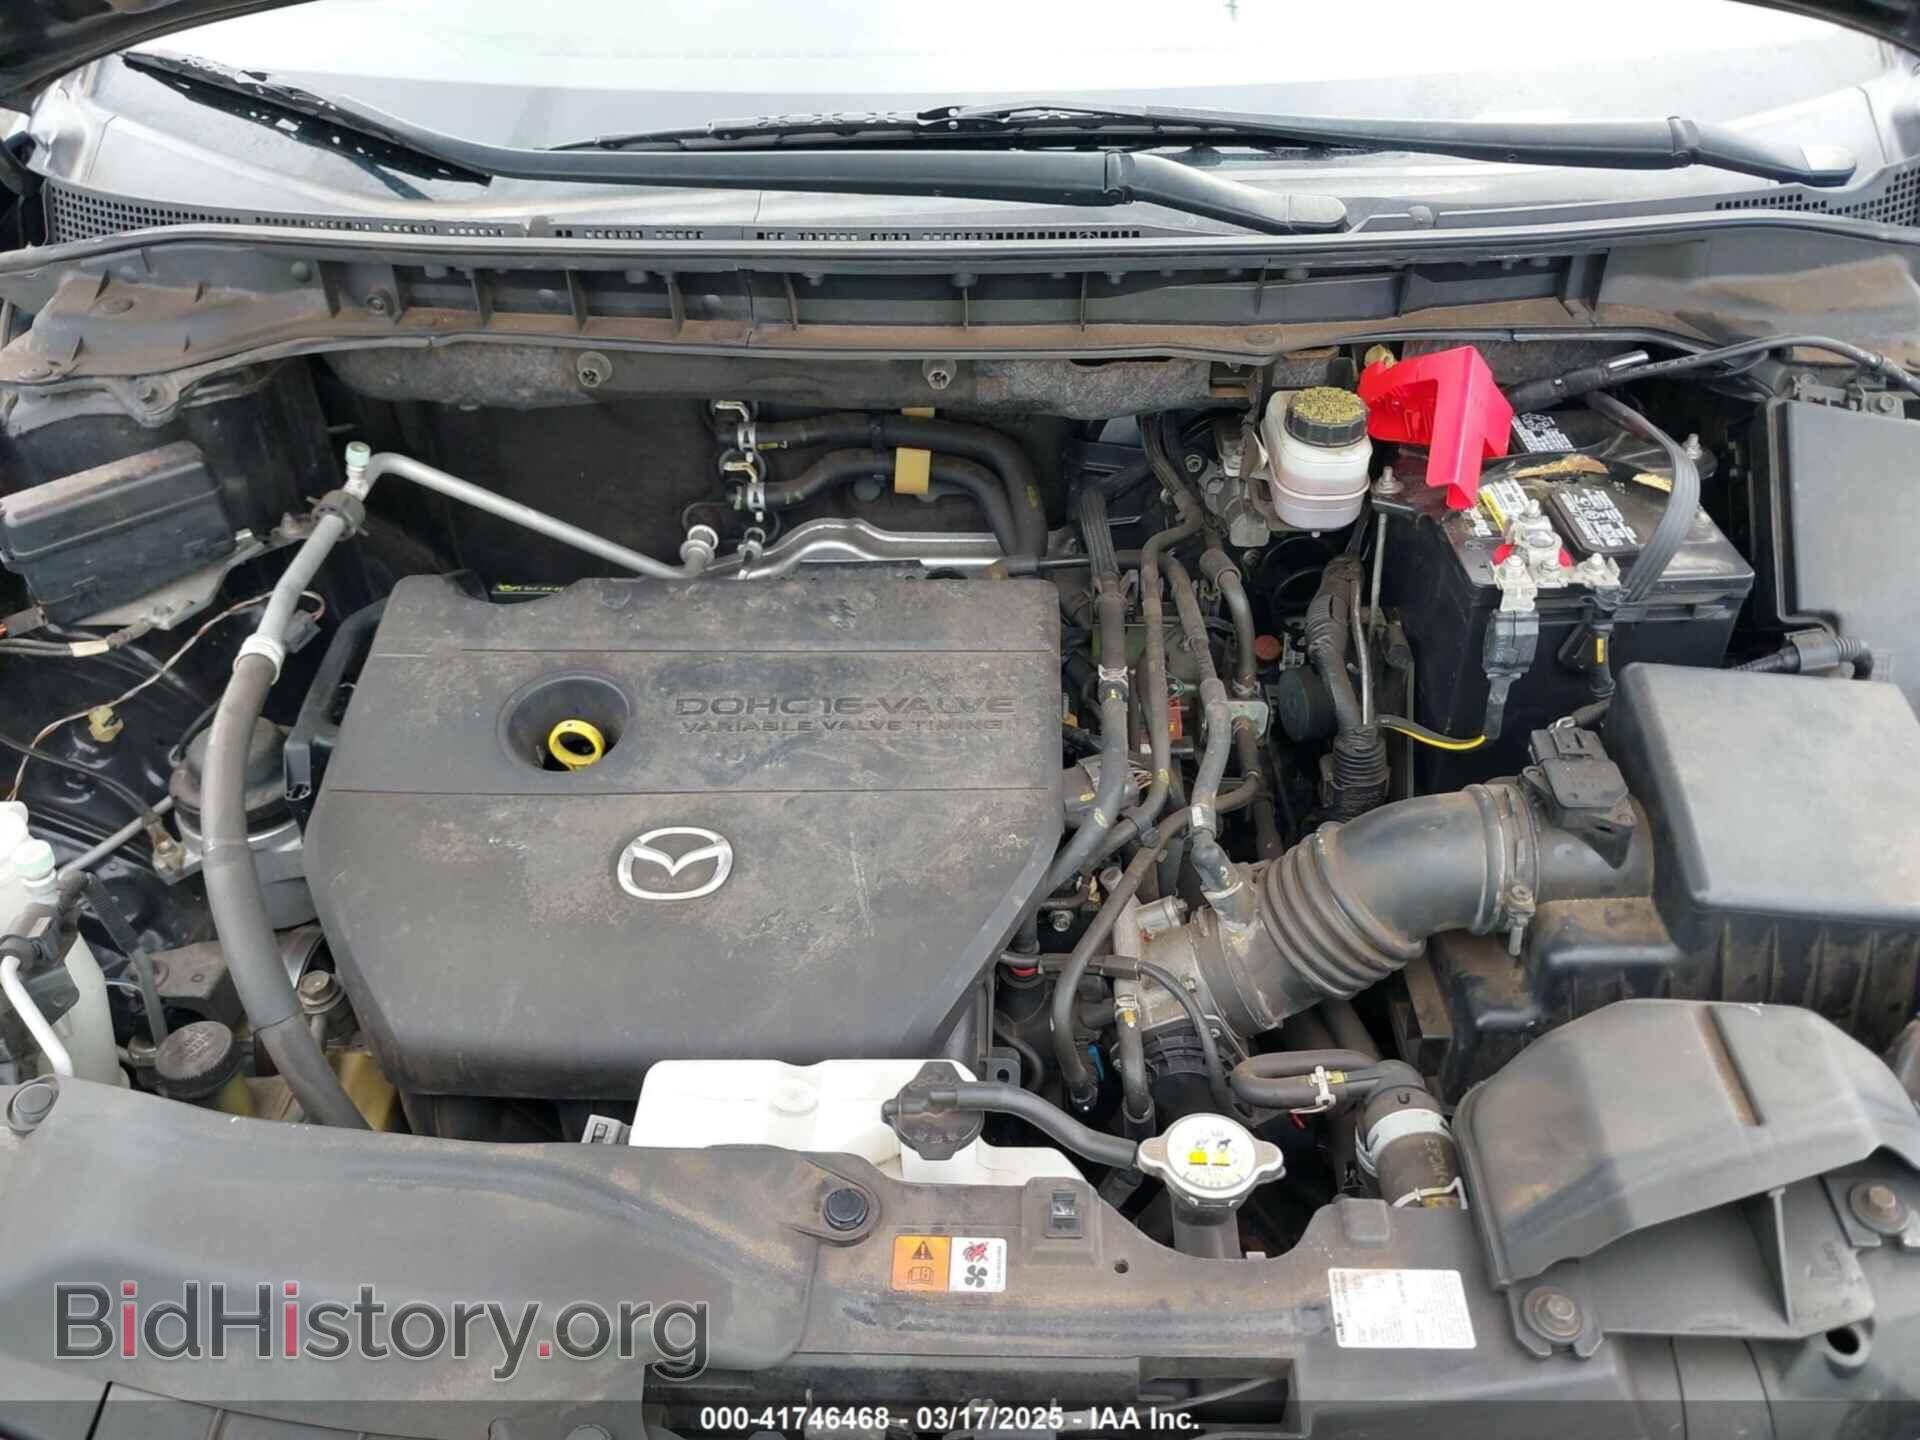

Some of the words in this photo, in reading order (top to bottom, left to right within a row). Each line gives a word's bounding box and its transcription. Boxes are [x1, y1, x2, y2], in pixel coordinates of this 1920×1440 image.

[675, 698, 810, 715] DOHC
[682, 719, 813, 732] VARIABLE
[822, 719, 902, 731] VALVE
[910, 719, 1002, 731] TIMING
